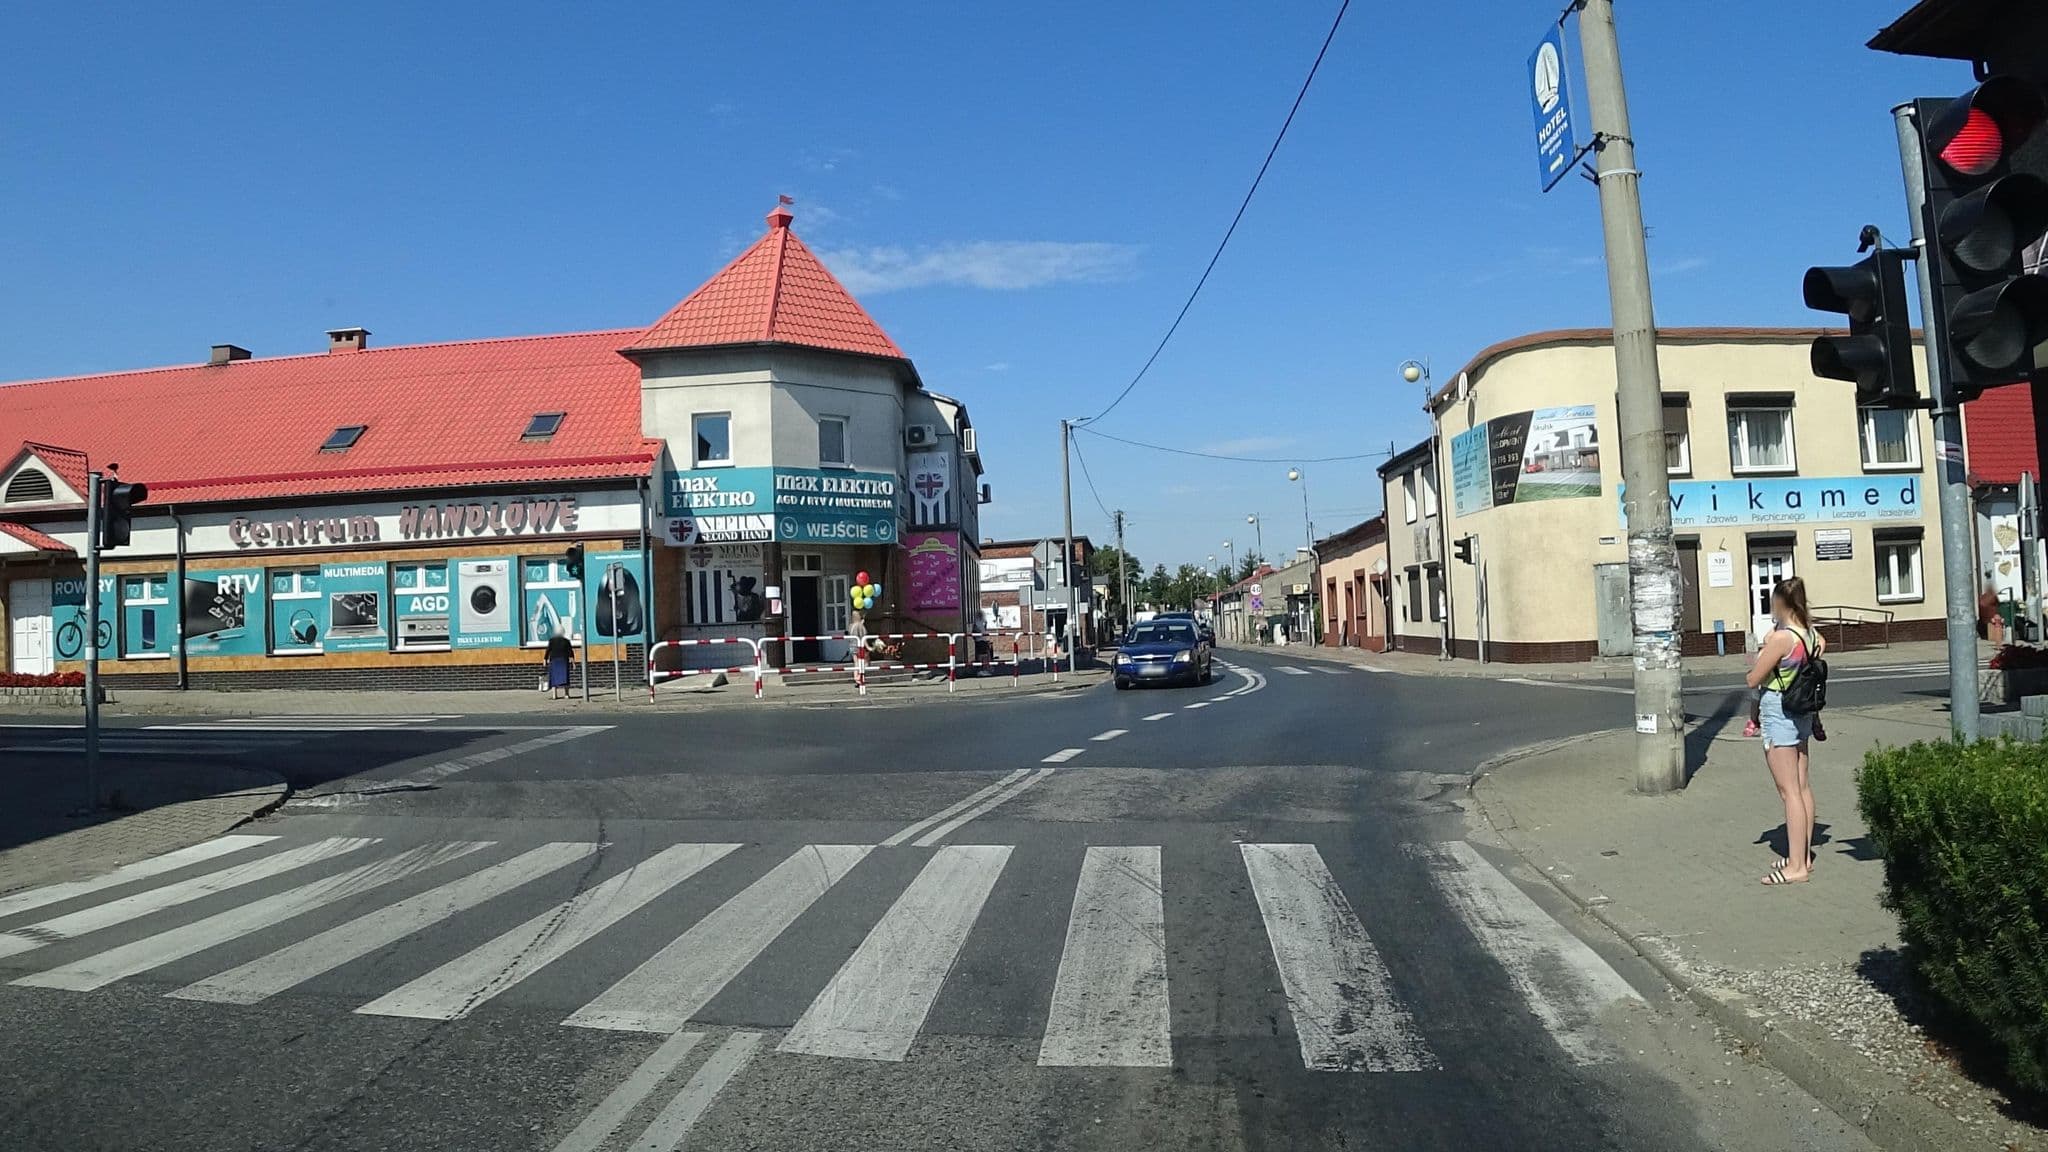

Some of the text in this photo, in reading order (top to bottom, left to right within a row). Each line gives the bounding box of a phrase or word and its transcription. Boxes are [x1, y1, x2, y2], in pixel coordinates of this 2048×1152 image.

[1539, 107, 1567, 144] HOTEL
[672, 476, 719, 493] max
[775, 474, 895, 495] max ELEKTRO
[672, 491, 756, 508] ELEKTRO
[776, 495, 798, 505] AGD
[807, 496, 828, 506] RTV
[835, 497, 894, 509] MULTIMEDIA
[229, 499, 578, 546] Centrum HANDLOWE
[702, 515, 767, 530] NEPTUN
[1706, 514, 1738, 524] Zdrowia
[1751, 511, 1806, 523] Psychicznego
[1832, 509, 1867, 519] Leczenia
[702, 530, 769, 542] SECOND HAND
[806, 521, 868, 538] WEJŚCIE
[324, 566, 385, 578] MULTIMEDIA
[55, 578, 114, 595] ROWRY
[217, 573, 260, 595] RTV
[410, 596, 449, 612] AGD
